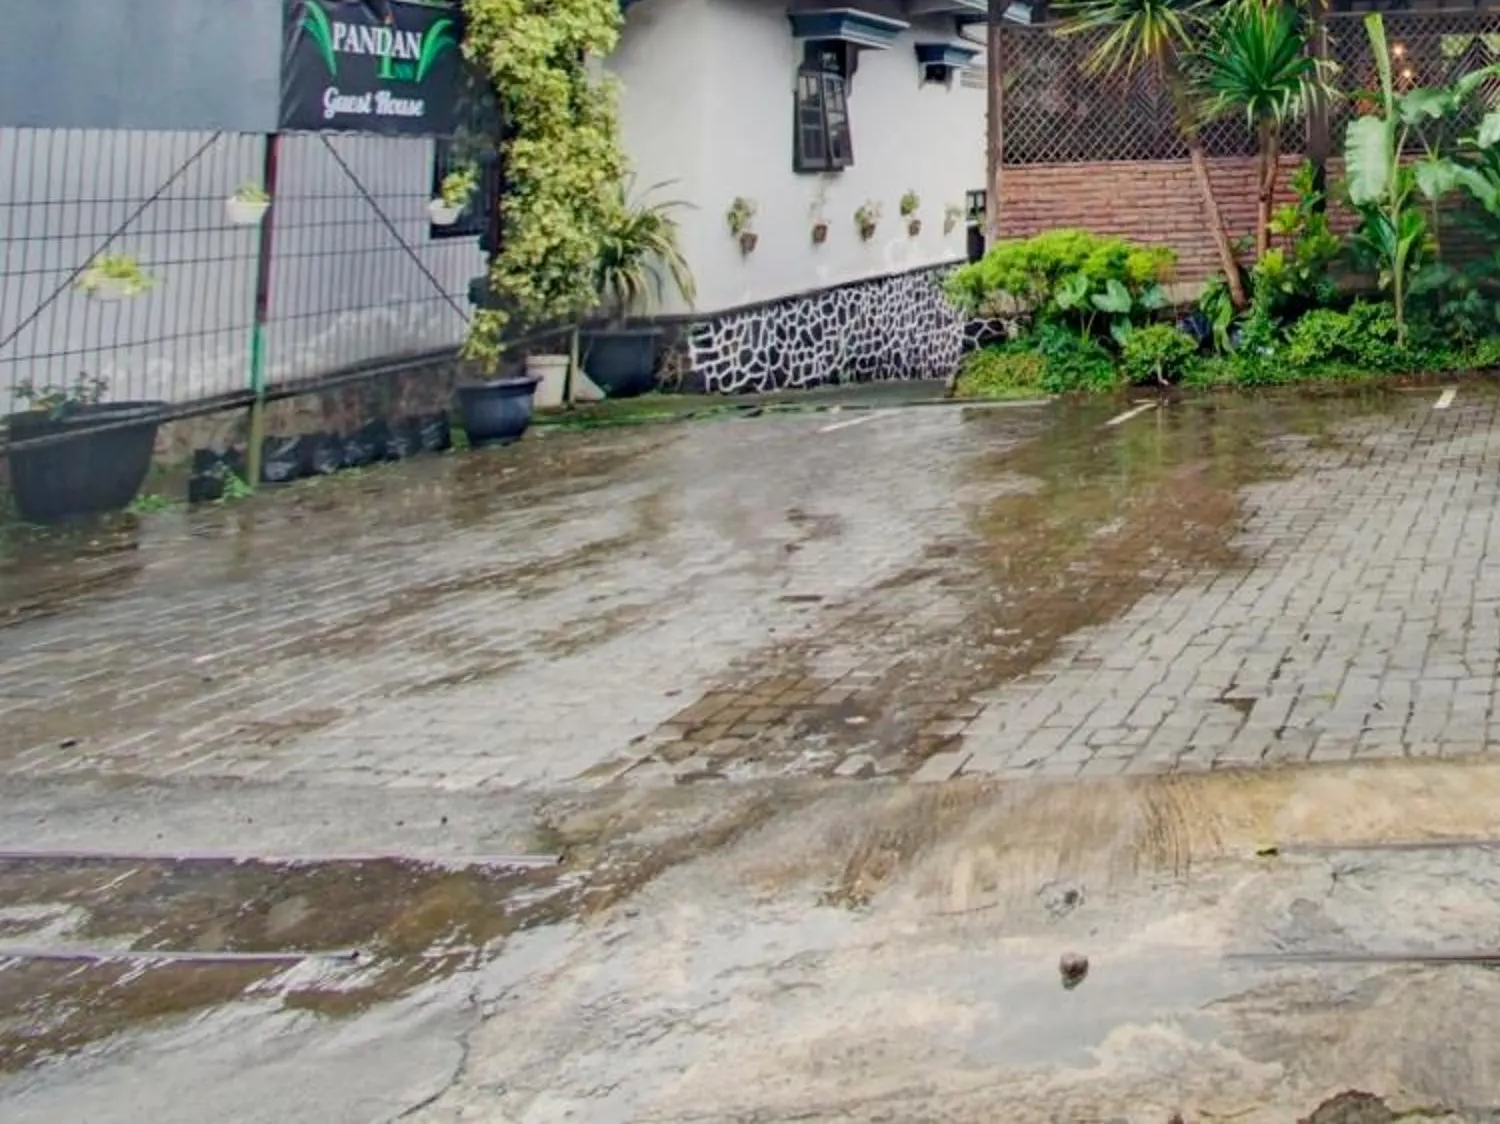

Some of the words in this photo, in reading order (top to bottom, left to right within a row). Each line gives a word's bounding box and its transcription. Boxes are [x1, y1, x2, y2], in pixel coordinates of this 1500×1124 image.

[333, 21, 422, 60] PANDAN
[323, 86, 371, 119] Guest
[375, 89, 425, 117] House
